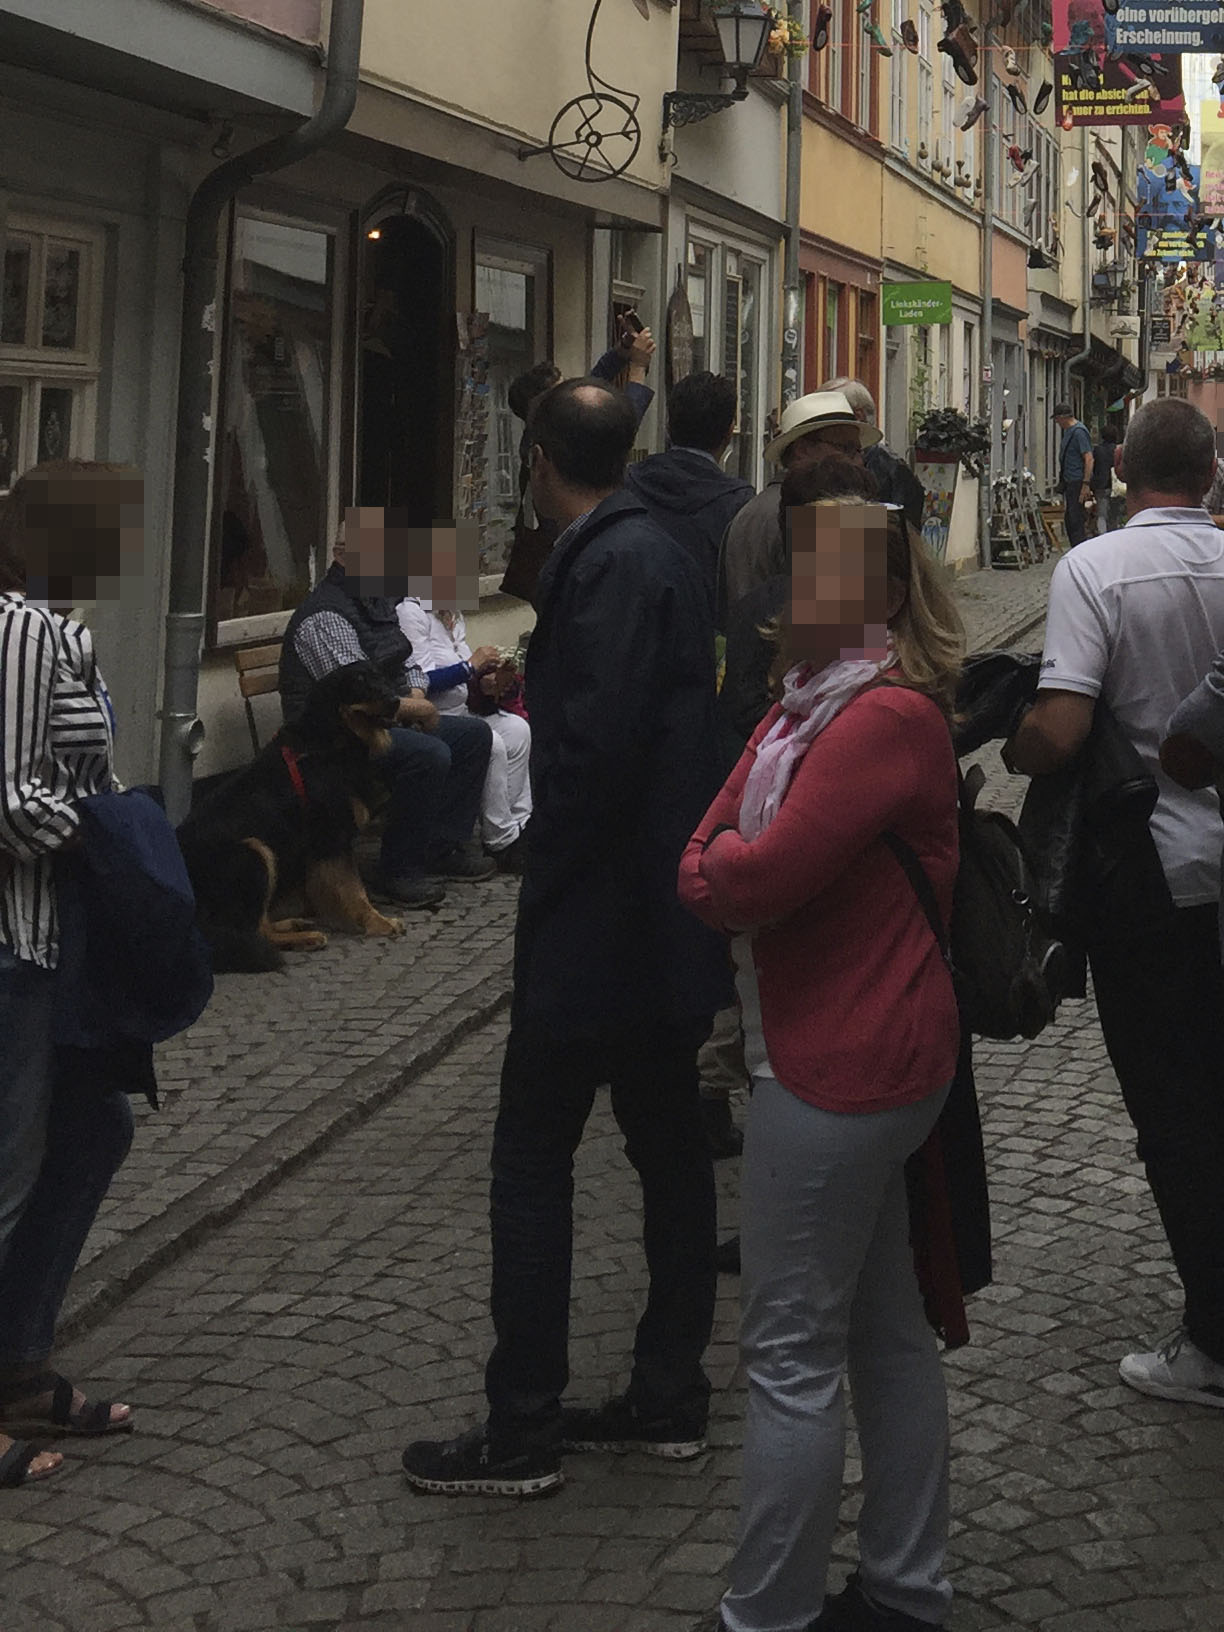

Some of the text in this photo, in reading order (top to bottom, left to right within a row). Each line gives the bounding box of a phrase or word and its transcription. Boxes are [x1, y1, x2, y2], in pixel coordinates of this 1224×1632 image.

[1116, 7, 1146, 23] eine
[1116, 28, 1204, 46] Erscheinung.
[1062, 89, 1078, 101] hat
[1079, 89, 1095, 101] die
